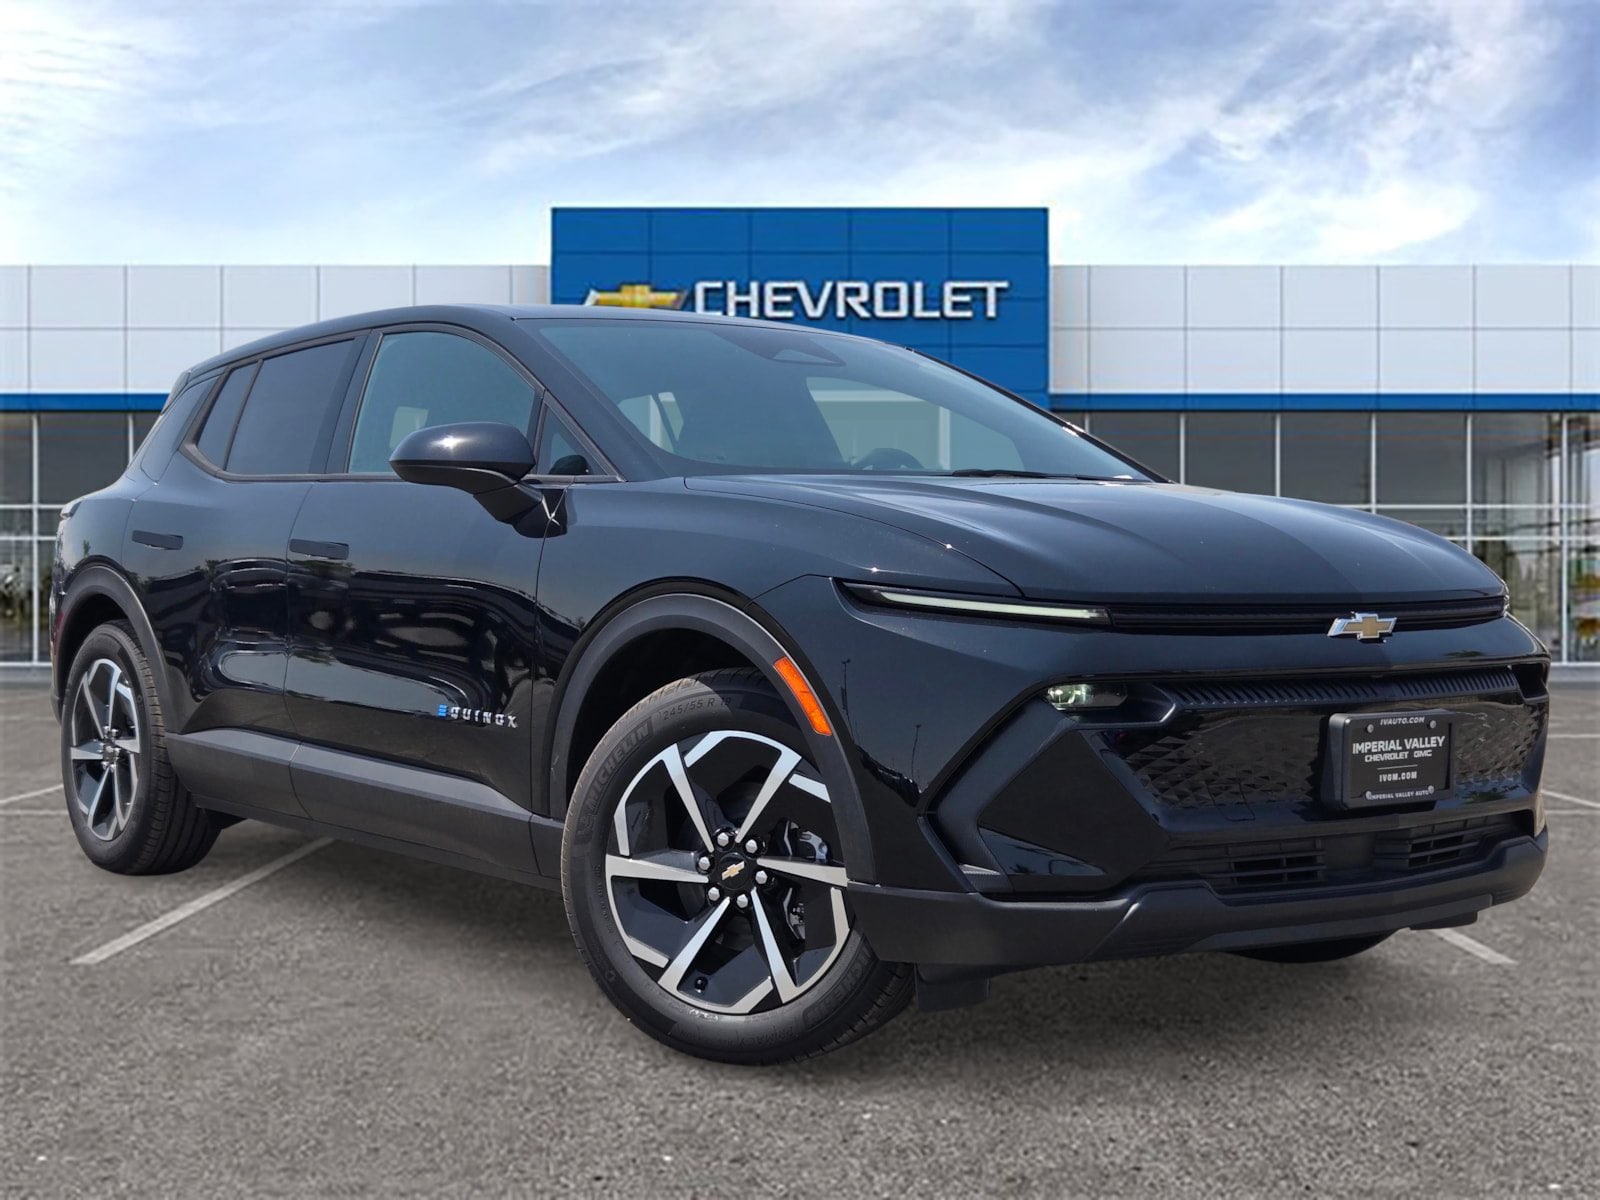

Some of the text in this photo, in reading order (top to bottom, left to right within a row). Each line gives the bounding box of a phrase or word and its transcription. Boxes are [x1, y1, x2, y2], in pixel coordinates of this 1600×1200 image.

[695, 281, 1009, 318] CHEVROLET
[437, 704, 518, 728] EQUINOX
[663, 700, 703, 721] 245/55
[707, 697, 716, 707] R
[1380, 716, 1425, 726] IVAUTO.COM
[1352, 735, 1446, 755] IMPERIAL VALLEY
[1364, 749, 1433, 763] CHEVROLET GMC
[587, 722, 651, 812] MICHELIN
[1379, 771, 1418, 782] IVGM.COM
